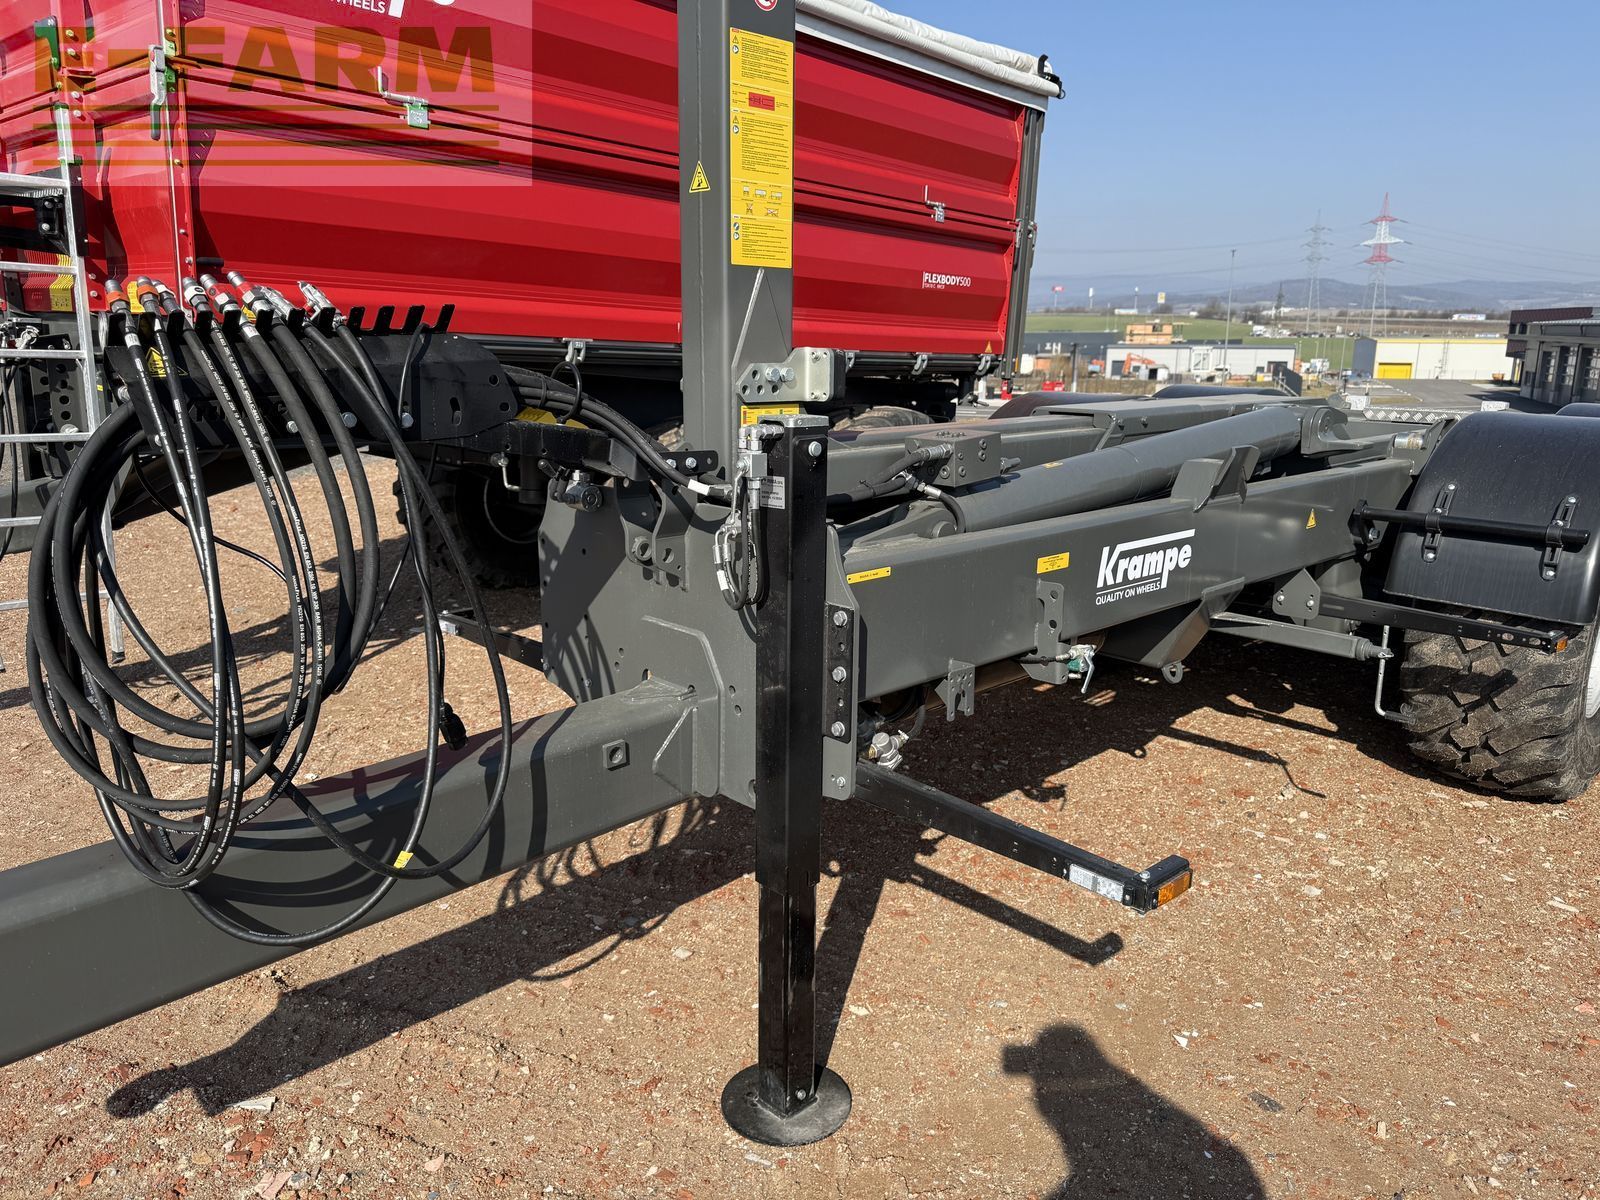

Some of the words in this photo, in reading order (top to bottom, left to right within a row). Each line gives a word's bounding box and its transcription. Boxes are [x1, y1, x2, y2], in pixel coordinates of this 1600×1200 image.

[1096, 528, 1196, 589] Krampe
[1095, 591, 1125, 605] QUALITY
[1124, 587, 1136, 599] ON
[1136, 582, 1160, 595] WHEELS
